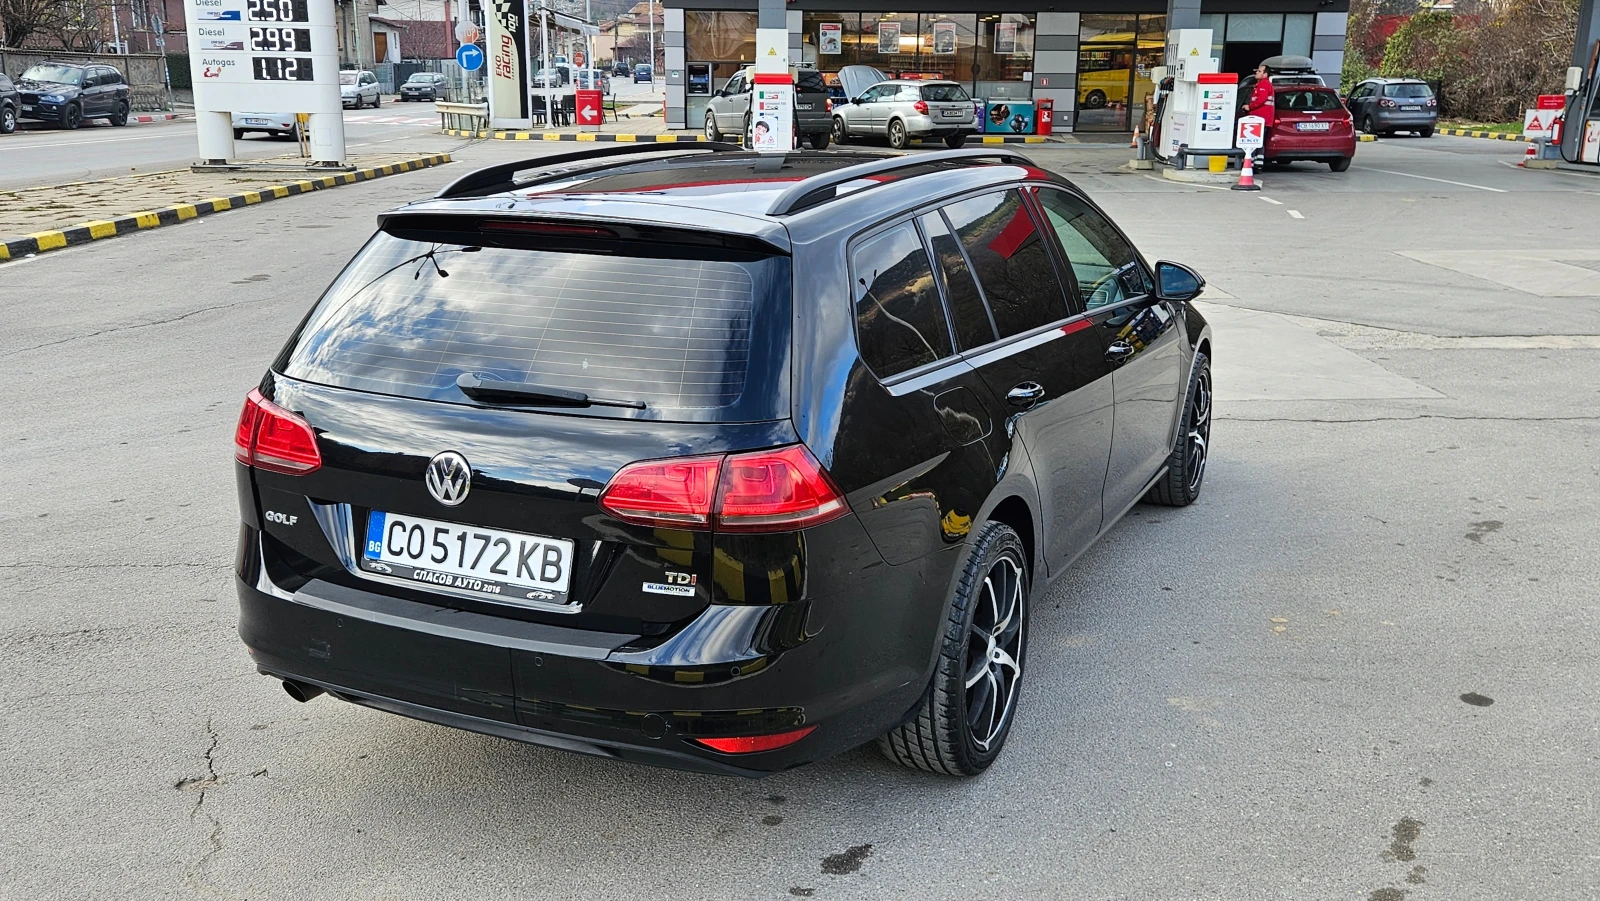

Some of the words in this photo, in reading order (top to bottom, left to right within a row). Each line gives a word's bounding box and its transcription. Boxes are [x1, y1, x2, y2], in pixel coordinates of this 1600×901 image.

[248, 0, 293, 21] 2.50
[198, 28, 225, 36] Diesel
[508, 13, 516, 32] 100
[251, 28, 296, 51] 2.99
[202, 58, 236, 67] Autogas
[501, 34, 513, 80] racing
[261, 57, 298, 80] 1.12
[265, 510, 298, 526] GOLF
[368, 540, 381, 552] BG
[413, 569, 454, 585] СПАСОВ
[454, 577, 482, 590] АУТО
[482, 584, 501, 593] 2016
[647, 584, 690, 593] BLUEMOTION
